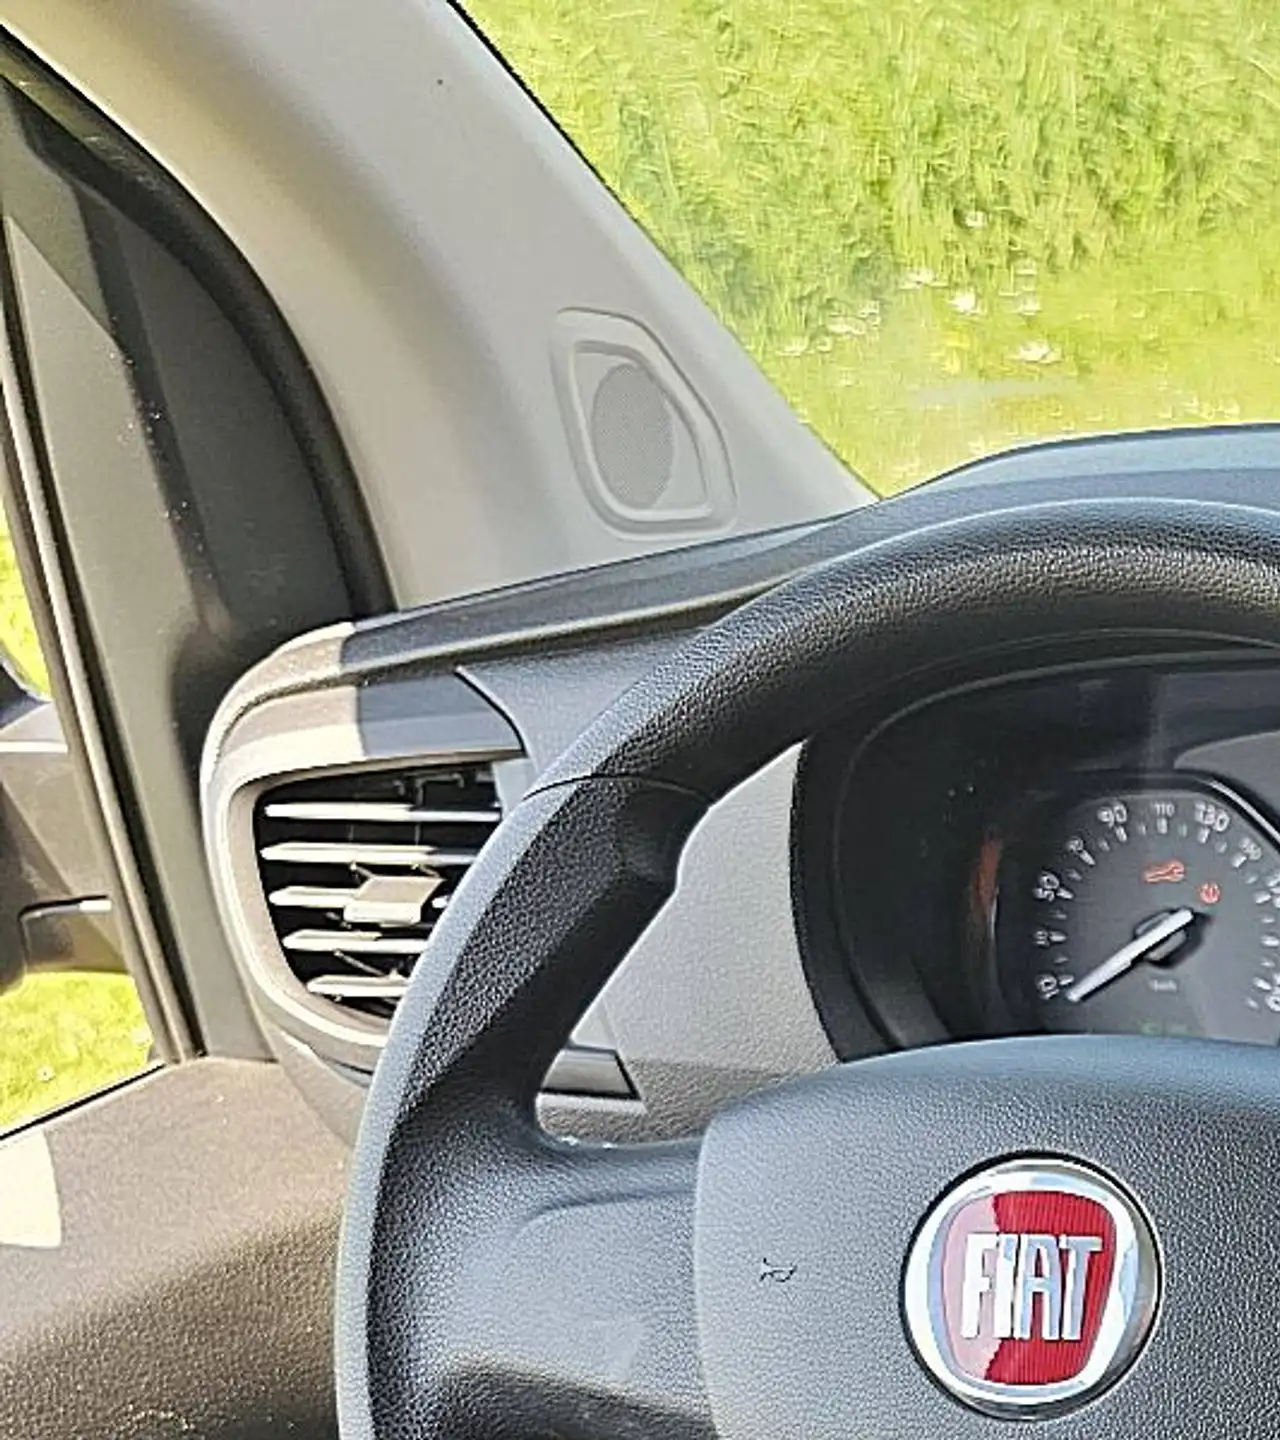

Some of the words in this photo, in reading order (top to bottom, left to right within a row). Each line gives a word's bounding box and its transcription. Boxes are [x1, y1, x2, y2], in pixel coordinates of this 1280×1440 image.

[1097, 804, 1127, 827] 90
[1153, 803, 1174, 816] 110
[1033, 873, 1060, 902] 50
[960, 1231, 1103, 1341] FIAT
